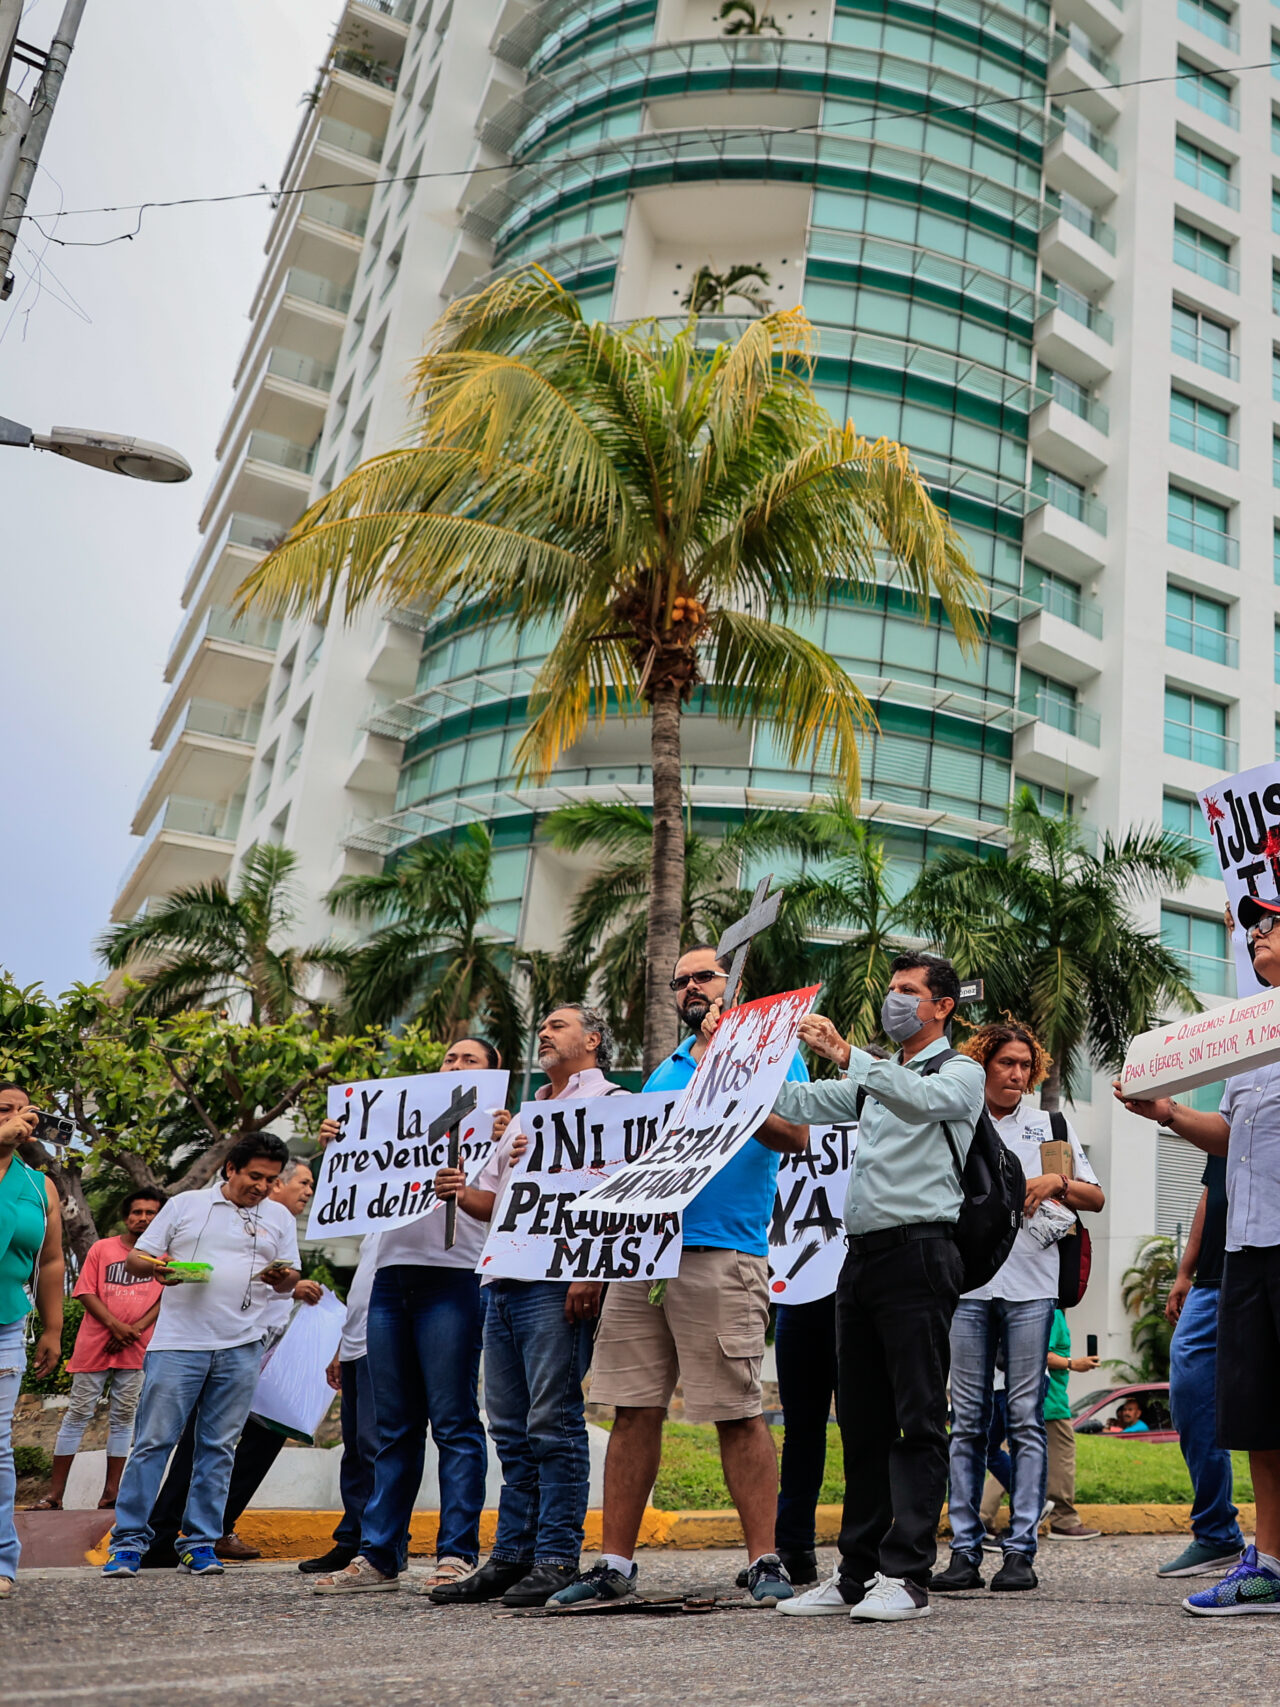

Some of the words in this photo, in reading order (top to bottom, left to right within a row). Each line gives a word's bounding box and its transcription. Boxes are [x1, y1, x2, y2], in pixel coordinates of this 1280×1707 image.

[1177, 1014, 1225, 1041] QUEREMOS
[1228, 999, 1275, 1025] LIBERTAD
[1124, 1063, 1146, 1084] PARA
[1188, 1039, 1204, 1064] SIN
[1206, 1034, 1240, 1059] TEMOR
[1245, 1028, 1256, 1046] A
[397, 1089, 430, 1141] la
[328, 1127, 493, 1183] prevencón
[317, 1184, 357, 1226] del
[589, 1165, 712, 1204] MATANDO
[768, 1176, 844, 1247] YA
